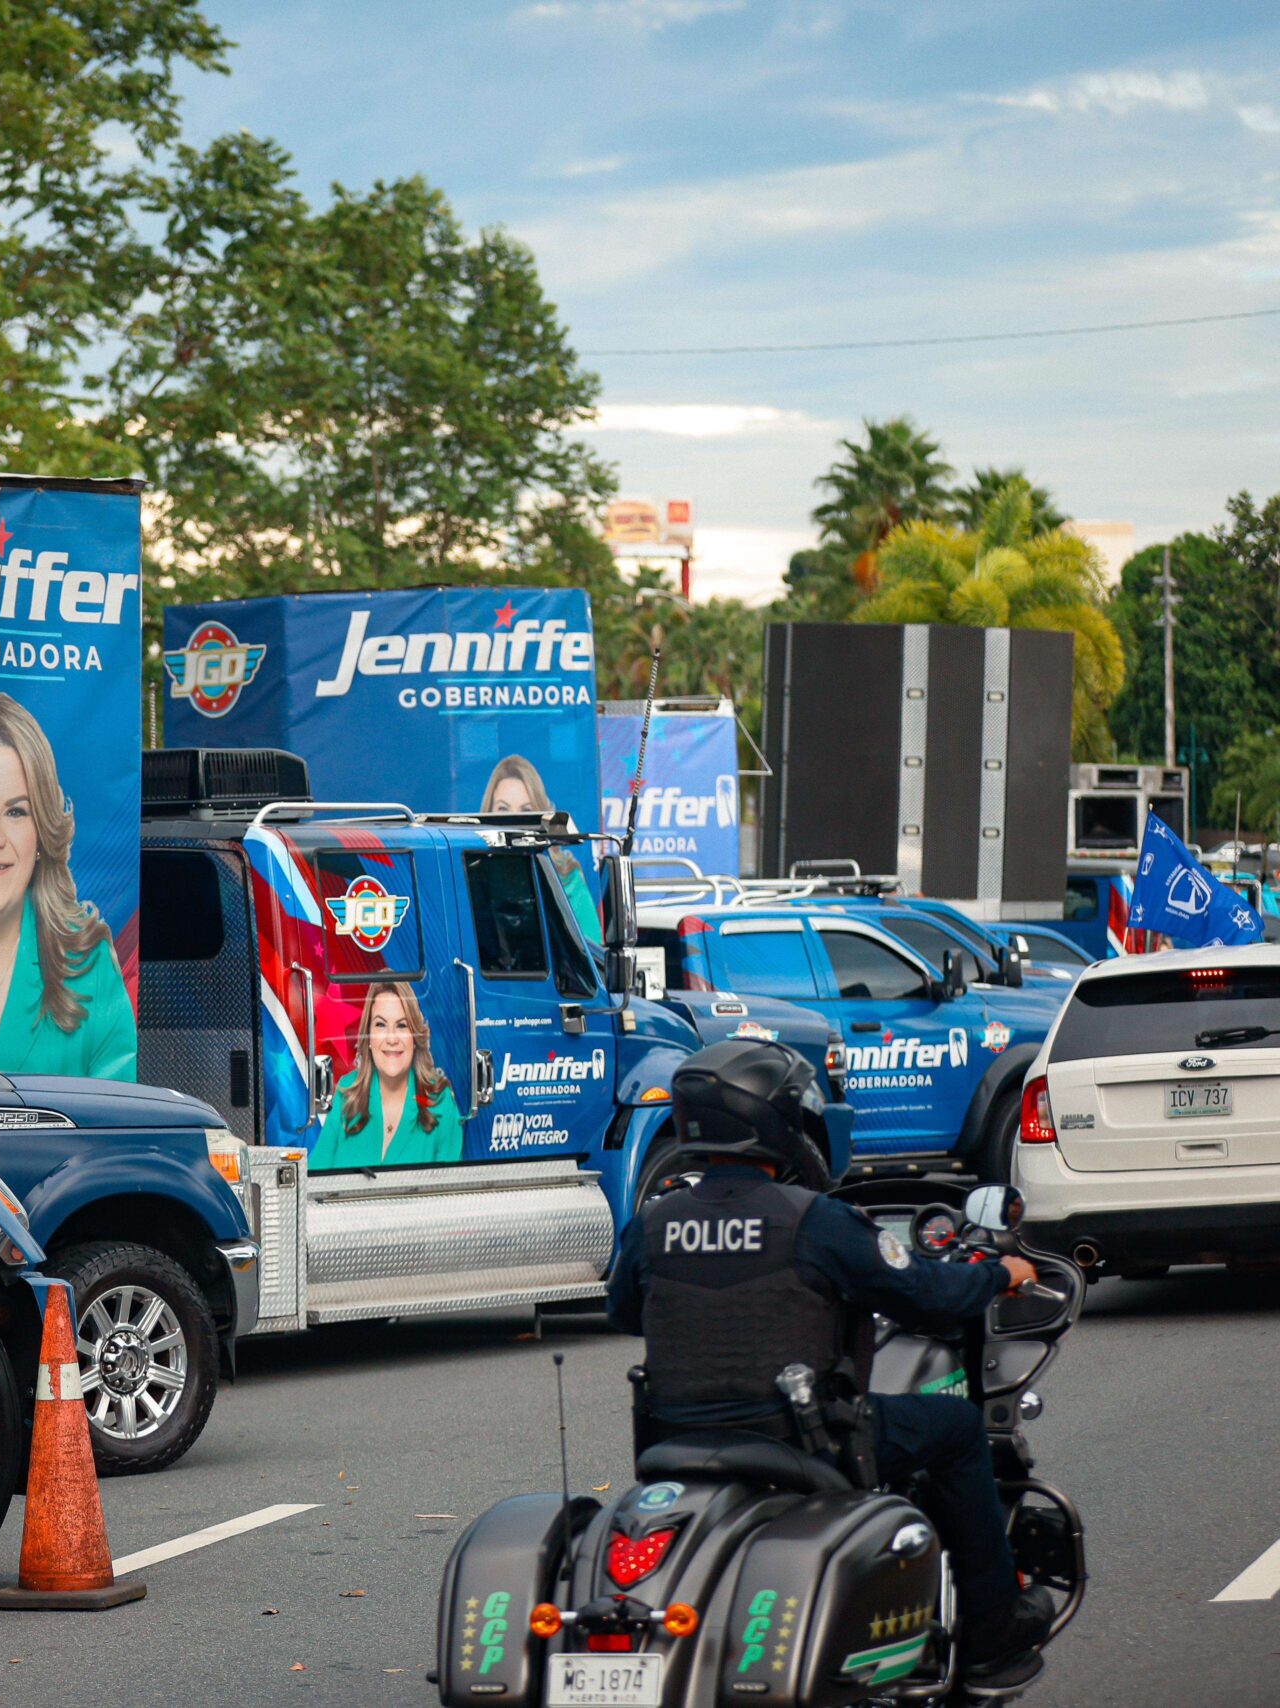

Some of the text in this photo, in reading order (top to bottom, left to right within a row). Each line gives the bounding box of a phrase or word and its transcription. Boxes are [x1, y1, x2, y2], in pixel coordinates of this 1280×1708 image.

[171, 649, 248, 698] JGO
[398, 684, 591, 709] GOBERNADORA
[336, 896, 396, 935] JGO
[495, 1052, 593, 1091] Jenniffer
[517, 1085, 581, 1097] GOBERNADORA
[1170, 1088, 1229, 1108] ICV 737
[525, 1113, 553, 1129] VOTA
[521, 1129, 569, 1146] ÍNTEGRO
[664, 1218, 762, 1253] POLICE
